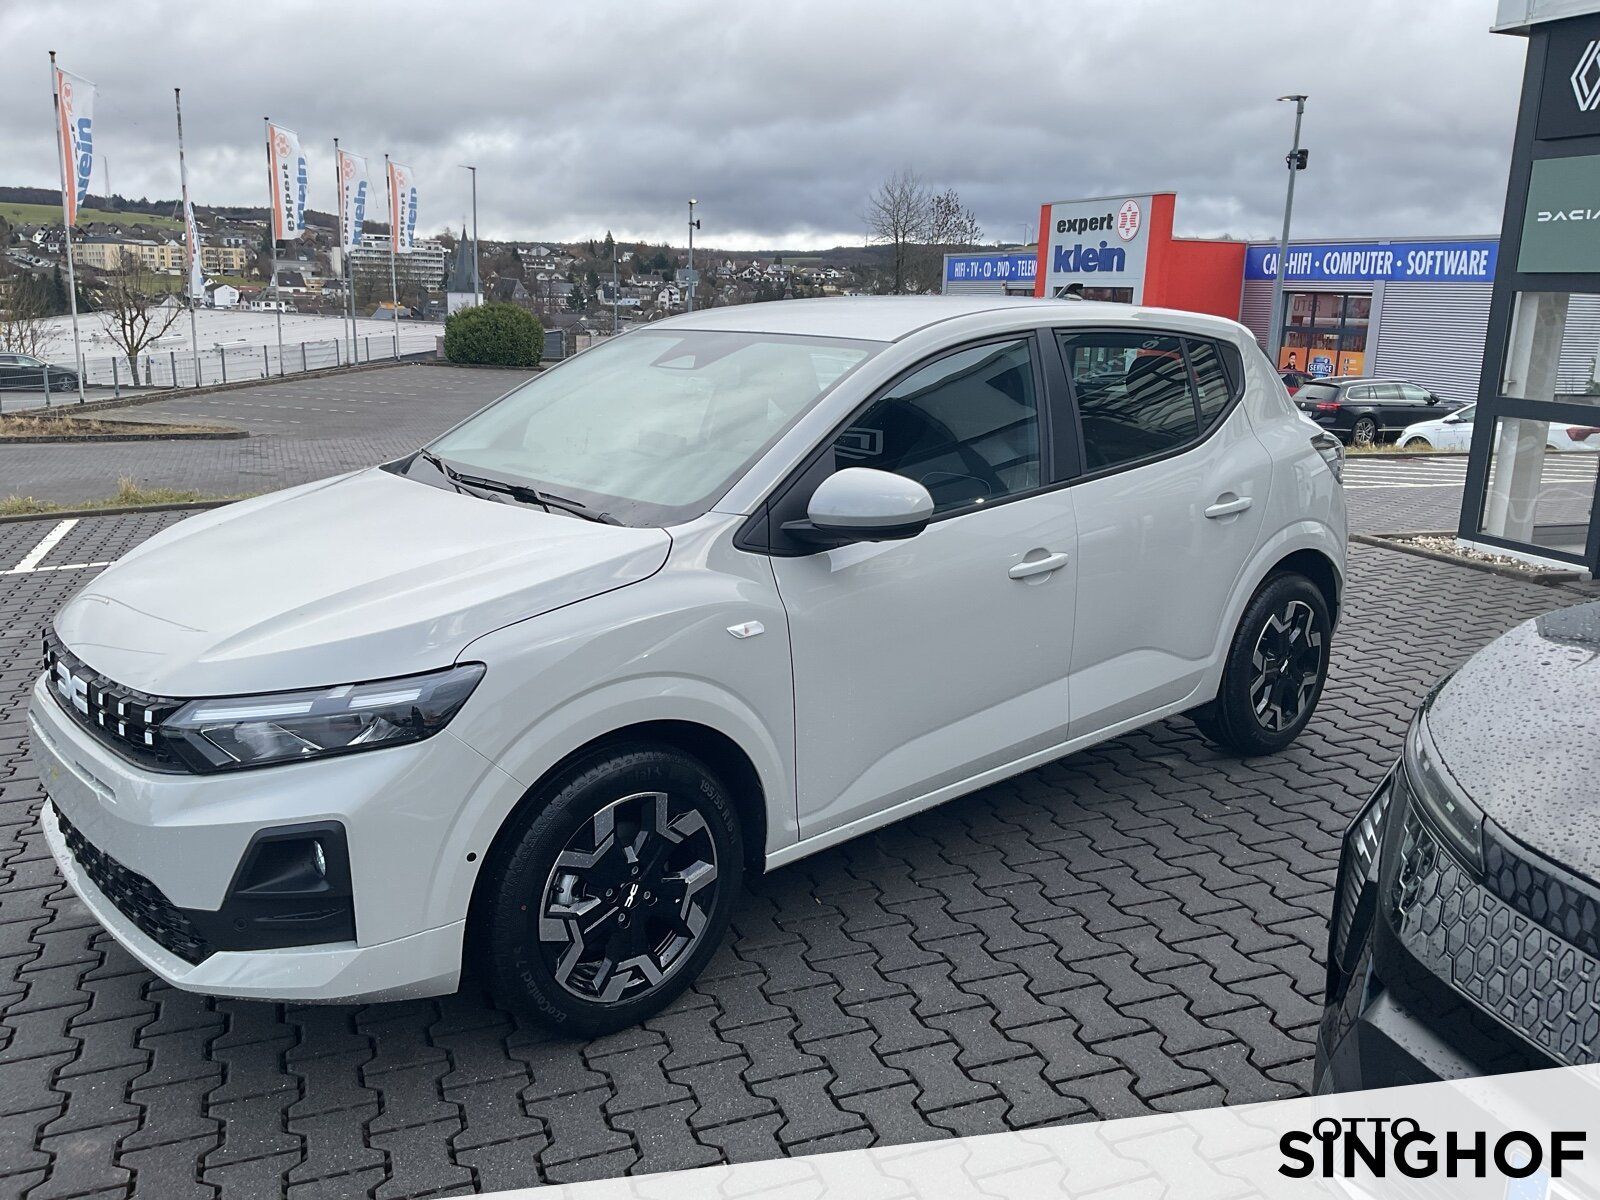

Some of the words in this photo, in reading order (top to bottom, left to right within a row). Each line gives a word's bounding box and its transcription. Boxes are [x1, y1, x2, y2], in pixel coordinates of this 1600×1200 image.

[282, 163, 295, 231] expert
[352, 180, 367, 245] klein
[1057, 213, 1114, 235] expert
[954, 262, 966, 277] HIFI
[970, 262, 979, 277] TV
[983, 262, 992, 277] CD
[997, 261, 1010, 277] DVD
[1053, 240, 1126, 273] klein
[1323, 251, 1394, 275] COMPUTER
[1407, 250, 1489, 275] SOFTWARE
[700, 779, 726, 810] 195/55
